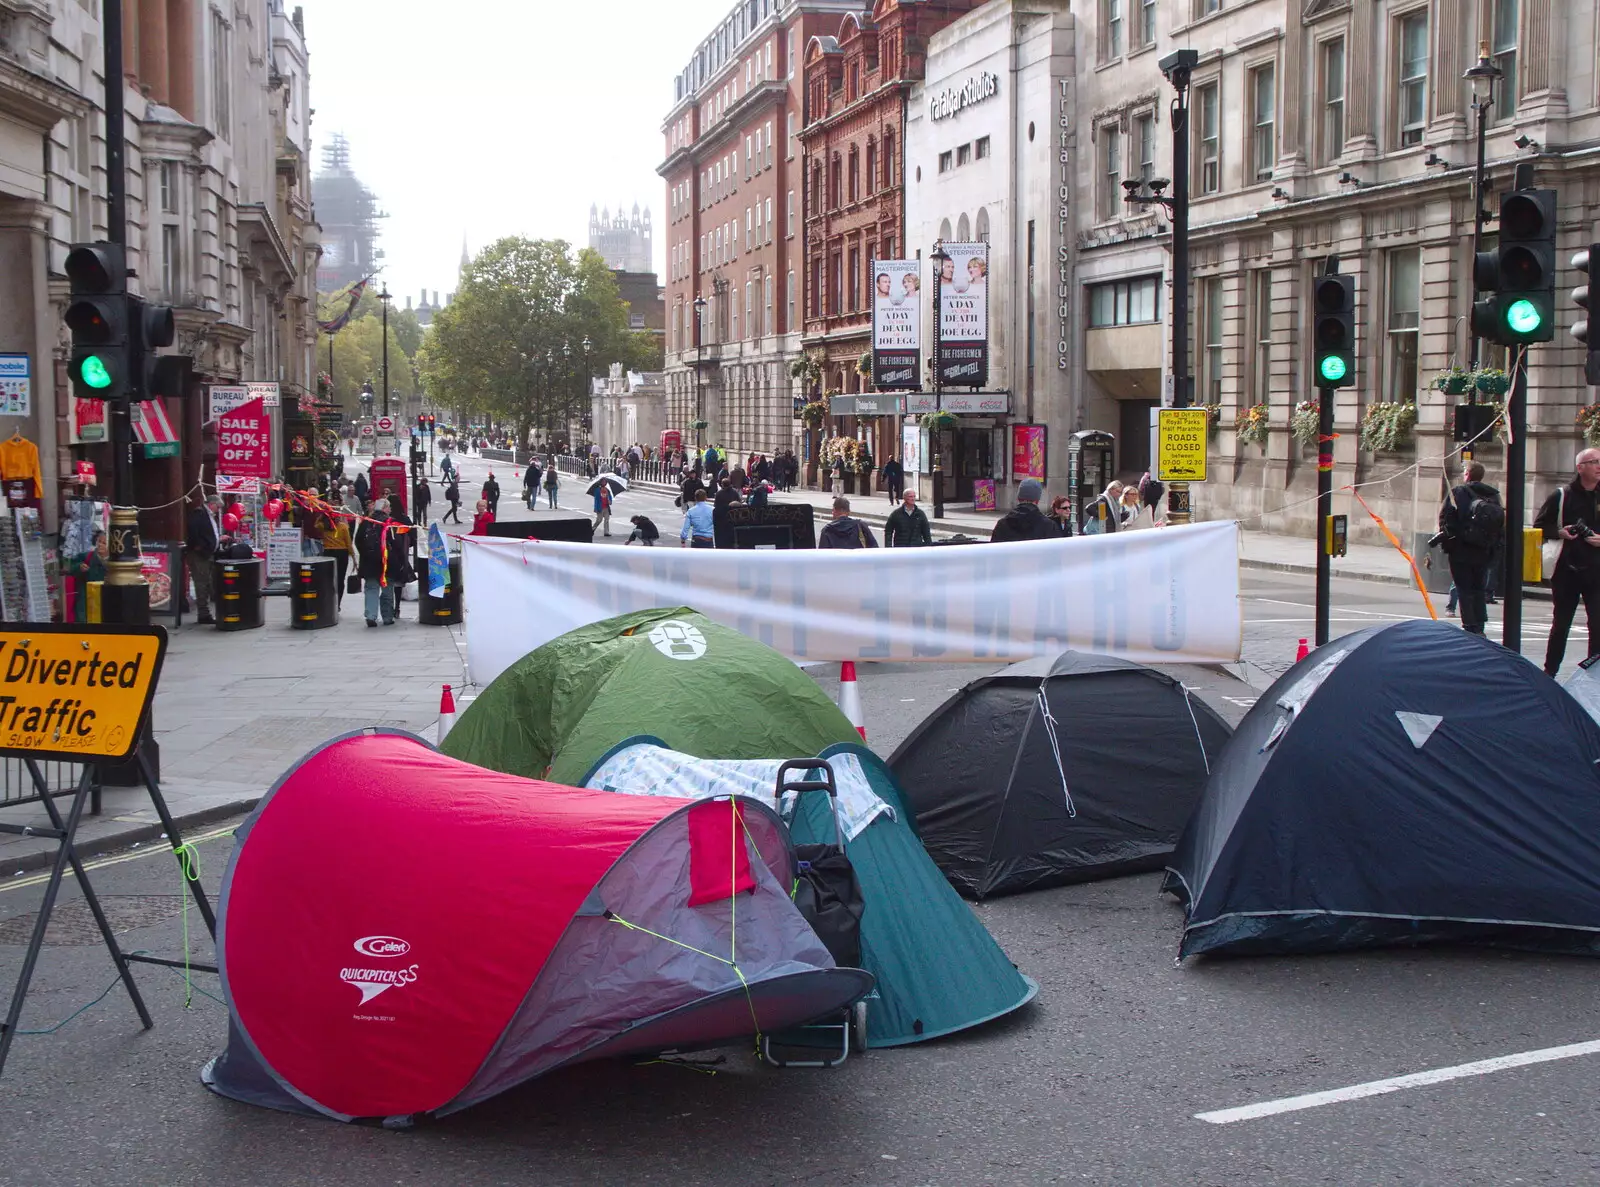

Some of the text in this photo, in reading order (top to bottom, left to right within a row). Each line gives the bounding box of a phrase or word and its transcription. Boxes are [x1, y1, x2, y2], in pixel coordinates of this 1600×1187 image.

[928, 71, 998, 122] Trafalgar Studios
[1058, 79, 1069, 369] Trafalgar Studios
[948, 300, 974, 308] A DAY
[945, 314, 978, 323] DEATH
[941, 328, 982, 336] JOE EGG
[879, 337, 916, 345] JOE EGG
[941, 348, 982, 359] THE FISHERMEN
[880, 356, 916, 365] THE FISHERMEN
[967, 361, 980, 375] FELL
[902, 368, 913, 381] FELL
[212, 392, 244, 400] BUREAU
[222, 418, 259, 429] SALE
[220, 432, 259, 447] 50%
[1165, 443, 1201, 451] CLOSED
[223, 449, 254, 460] OFF
[4, 648, 143, 688] Diverted
[0, 695, 97, 736] Traffic
[7, 733, 97, 748] SLOW PLEASE
[368, 939, 406, 953] Gelert
[339, 967, 397, 983] QUICKPITCH
